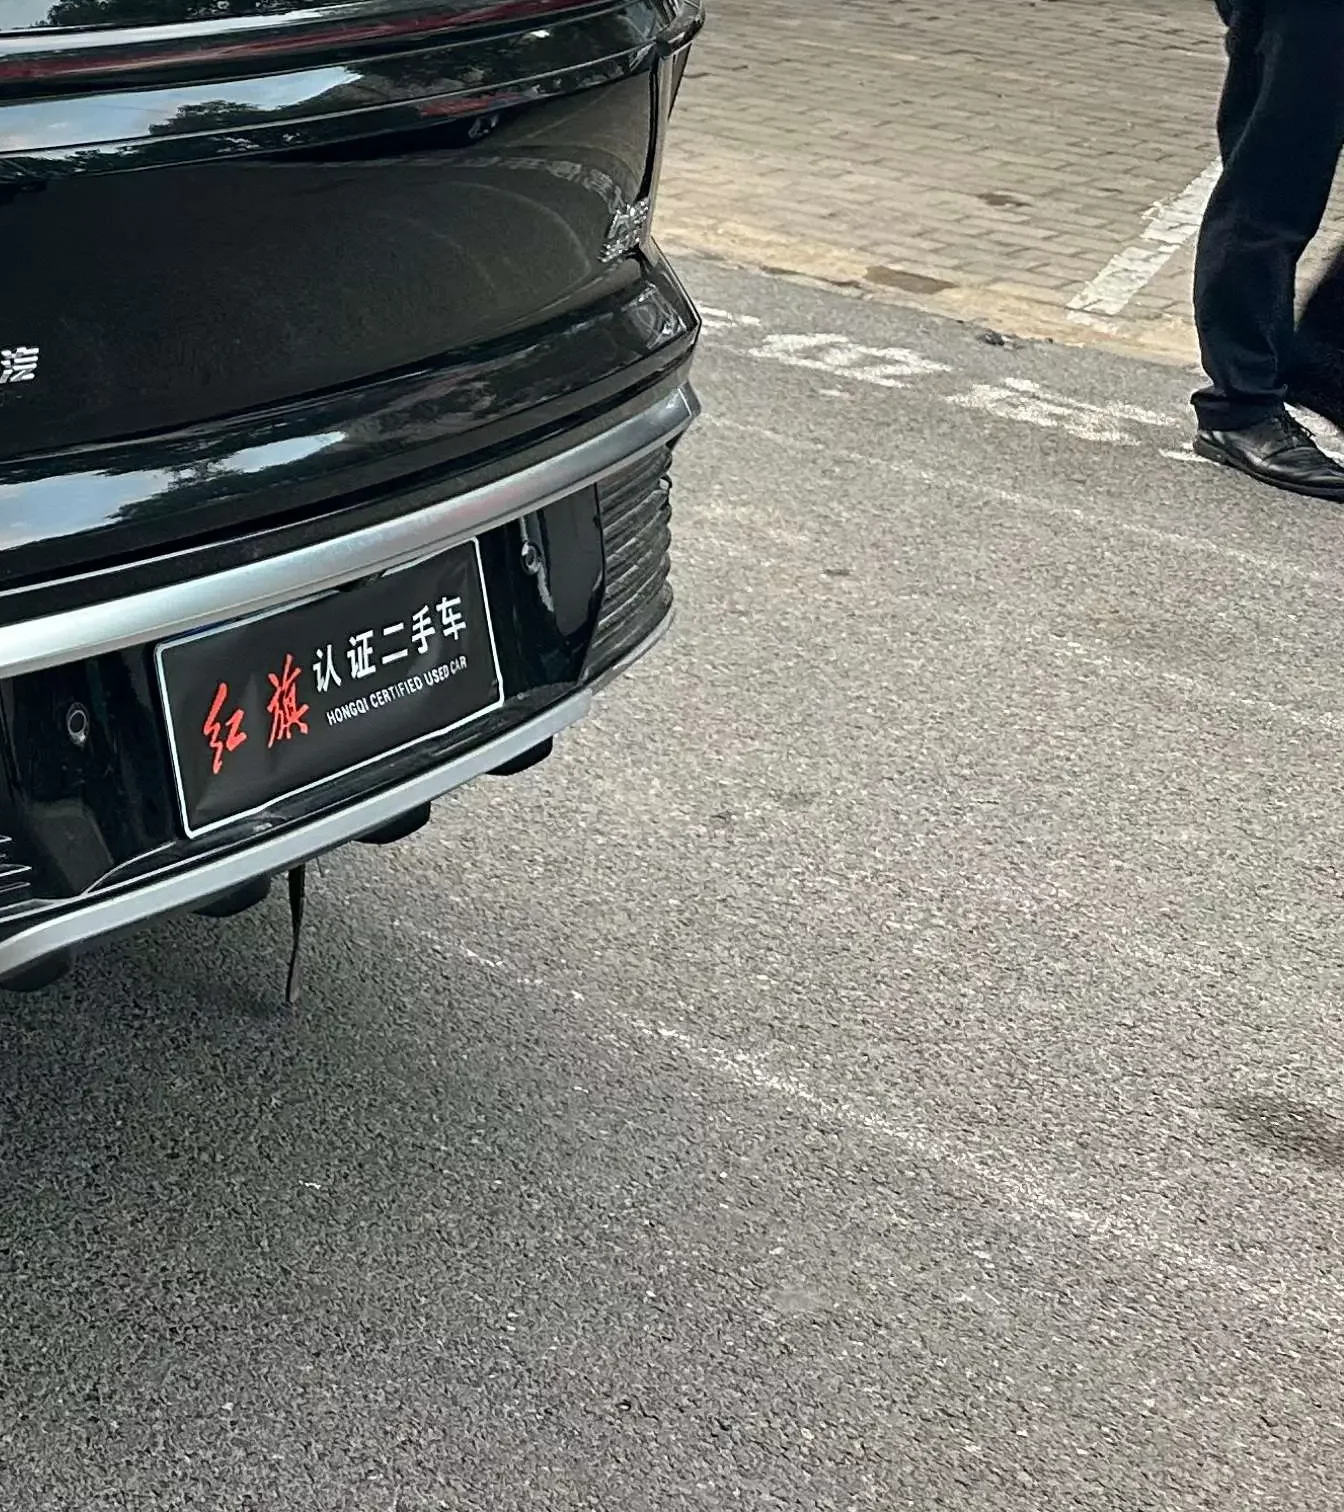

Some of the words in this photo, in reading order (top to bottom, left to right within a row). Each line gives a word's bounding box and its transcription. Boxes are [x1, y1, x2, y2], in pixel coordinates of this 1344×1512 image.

[203, 653, 308, 774] 红旗
[313, 595, 467, 692] 认证二手车
[326, 697, 369, 726] HONGQI
[369, 676, 423, 708] CERTIFIED
[424, 665, 450, 687] USED
[449, 655, 468, 676] CAR
